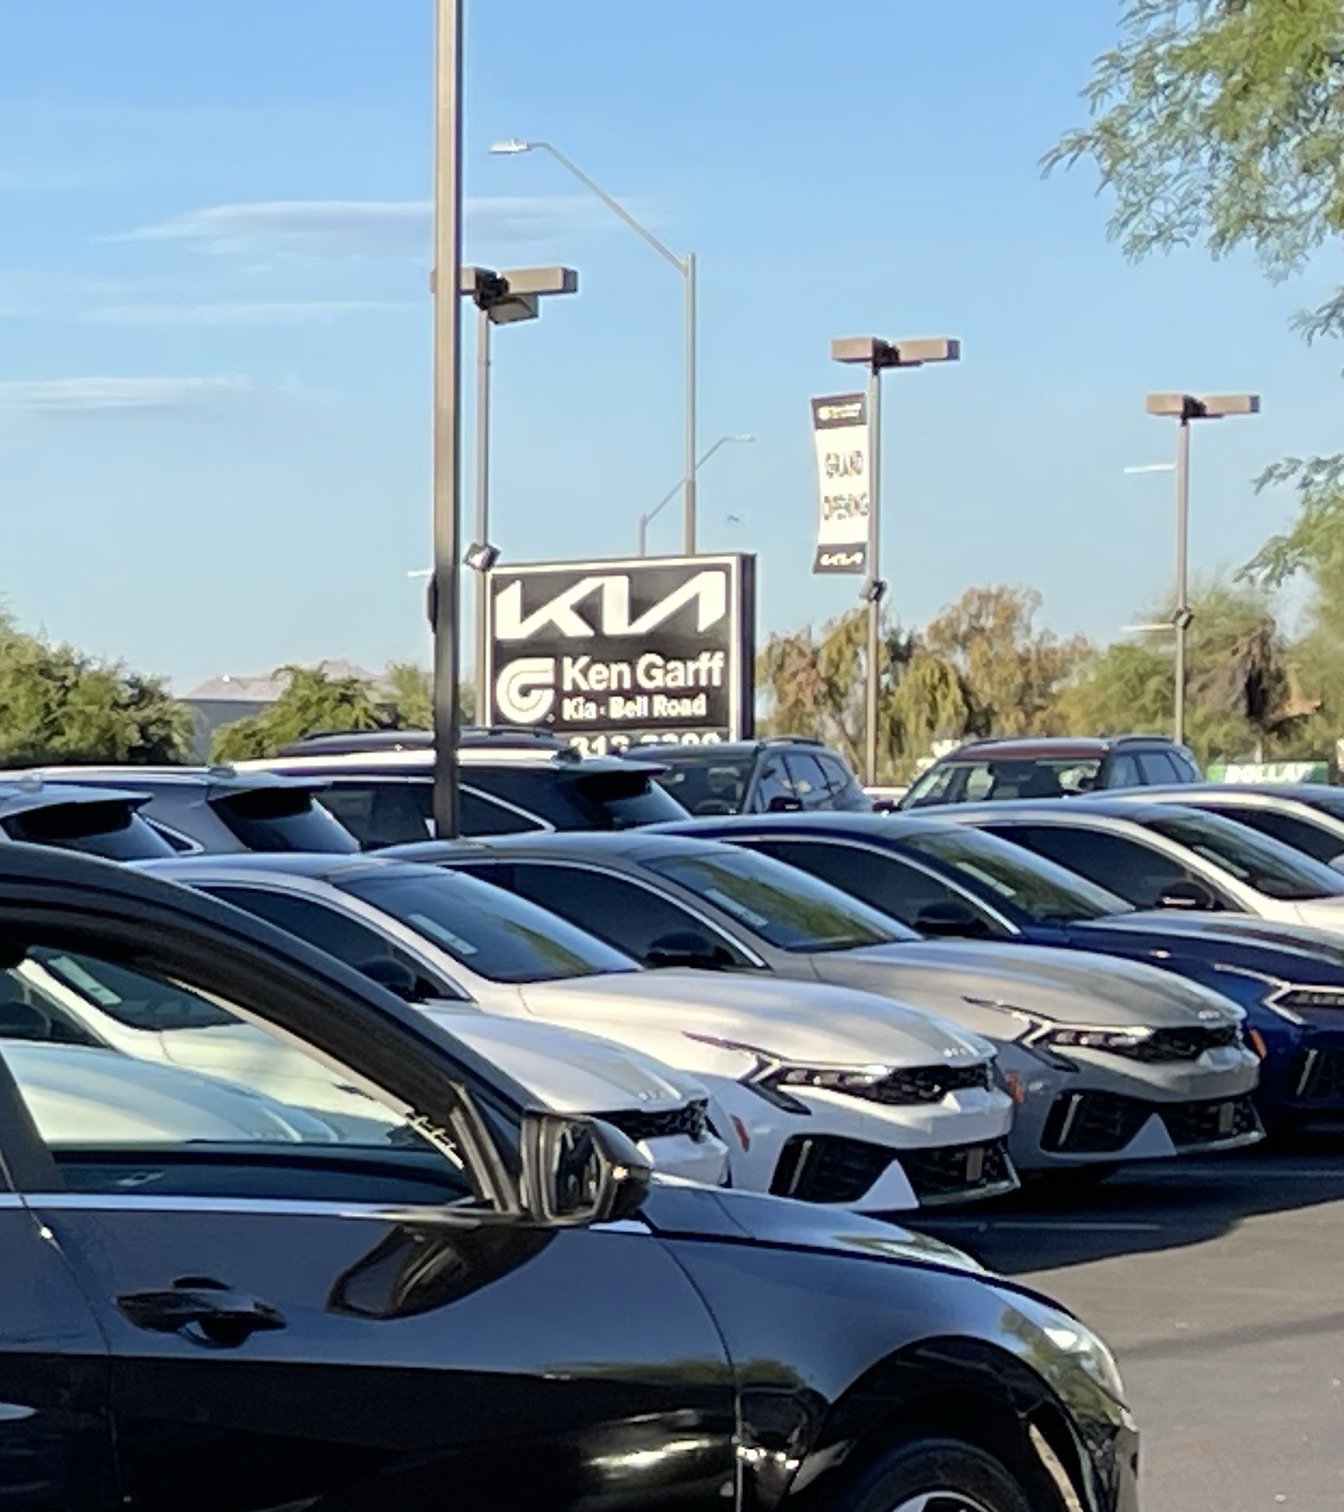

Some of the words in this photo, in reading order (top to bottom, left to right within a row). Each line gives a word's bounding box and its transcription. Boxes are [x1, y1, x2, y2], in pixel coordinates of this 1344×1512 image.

[496, 571, 726, 640] KIA
[563, 655, 631, 691] Ken
[636, 651, 725, 689] Garff
[563, 696, 597, 721] Kia
[609, 694, 648, 719] Bell
[653, 693, 707, 717] Road
